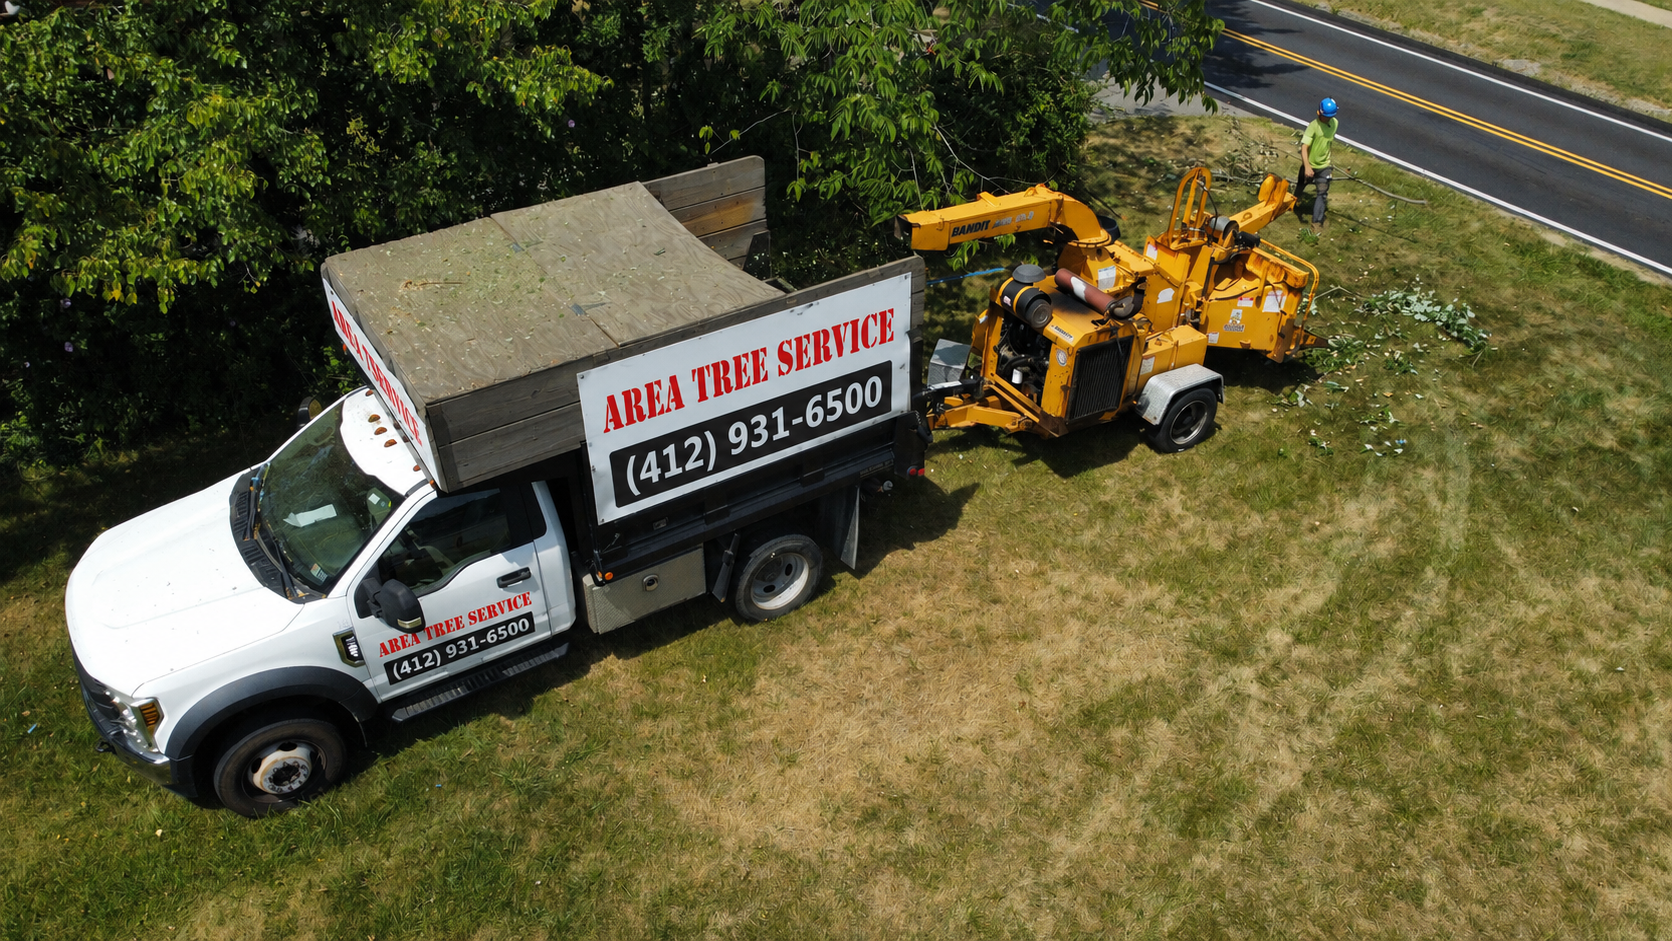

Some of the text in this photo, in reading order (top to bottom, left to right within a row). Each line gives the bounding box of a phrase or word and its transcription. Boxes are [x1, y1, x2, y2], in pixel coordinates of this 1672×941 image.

[951, 219, 991, 237] BANDIT
[332, 300, 364, 361] AREA
[603, 307, 895, 433] AREA TREE SERVICE
[625, 374, 884, 496] (412) 931-6500
[379, 633, 422, 658] AREA
[423, 615, 465, 641] TREE
[468, 591, 533, 626] SERVICE
[392, 617, 530, 681] (412) 931-6500
